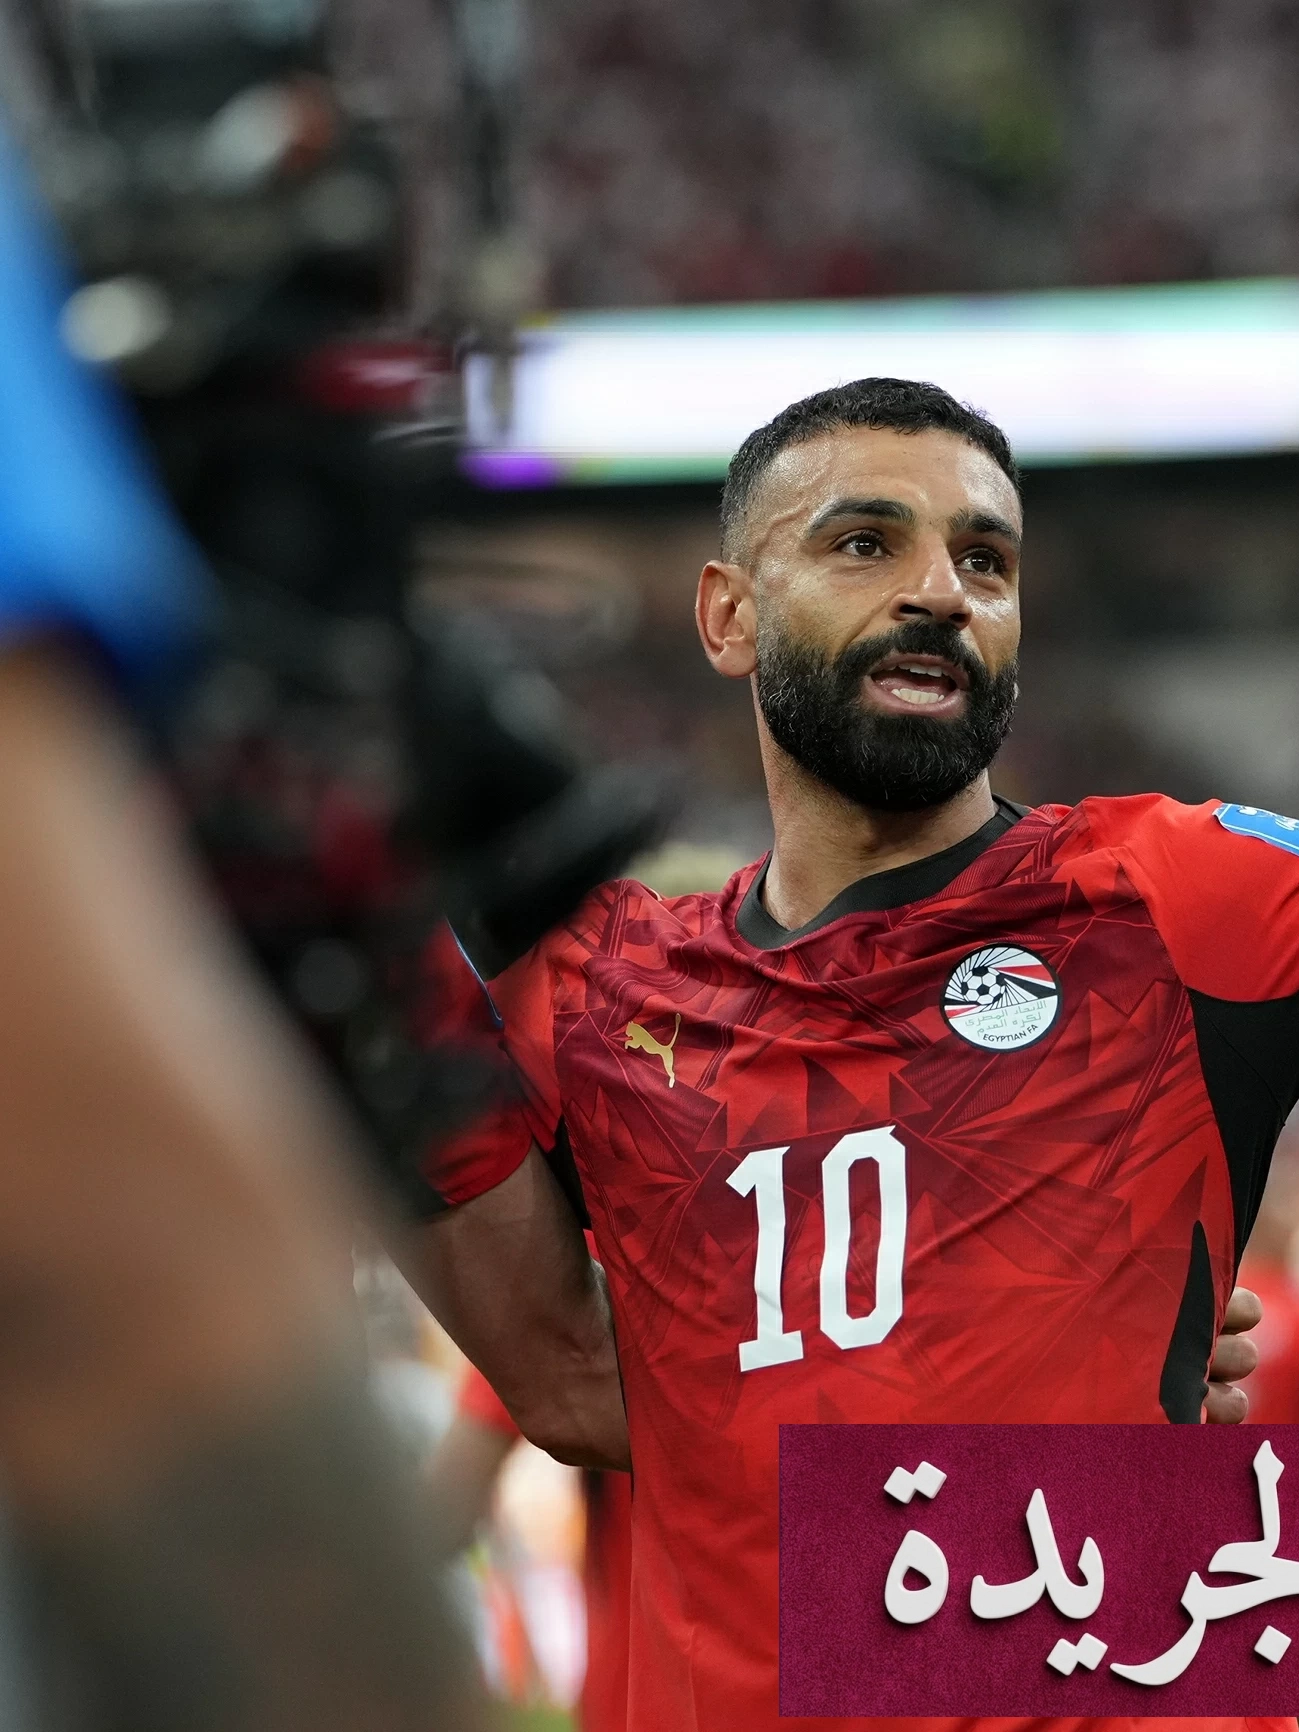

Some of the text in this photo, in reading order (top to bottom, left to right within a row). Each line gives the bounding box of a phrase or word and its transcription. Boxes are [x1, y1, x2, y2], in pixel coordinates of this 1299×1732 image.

[983, 1024, 1038, 1042] EGYPTIAN FA
[725, 1124, 907, 1373] 10
